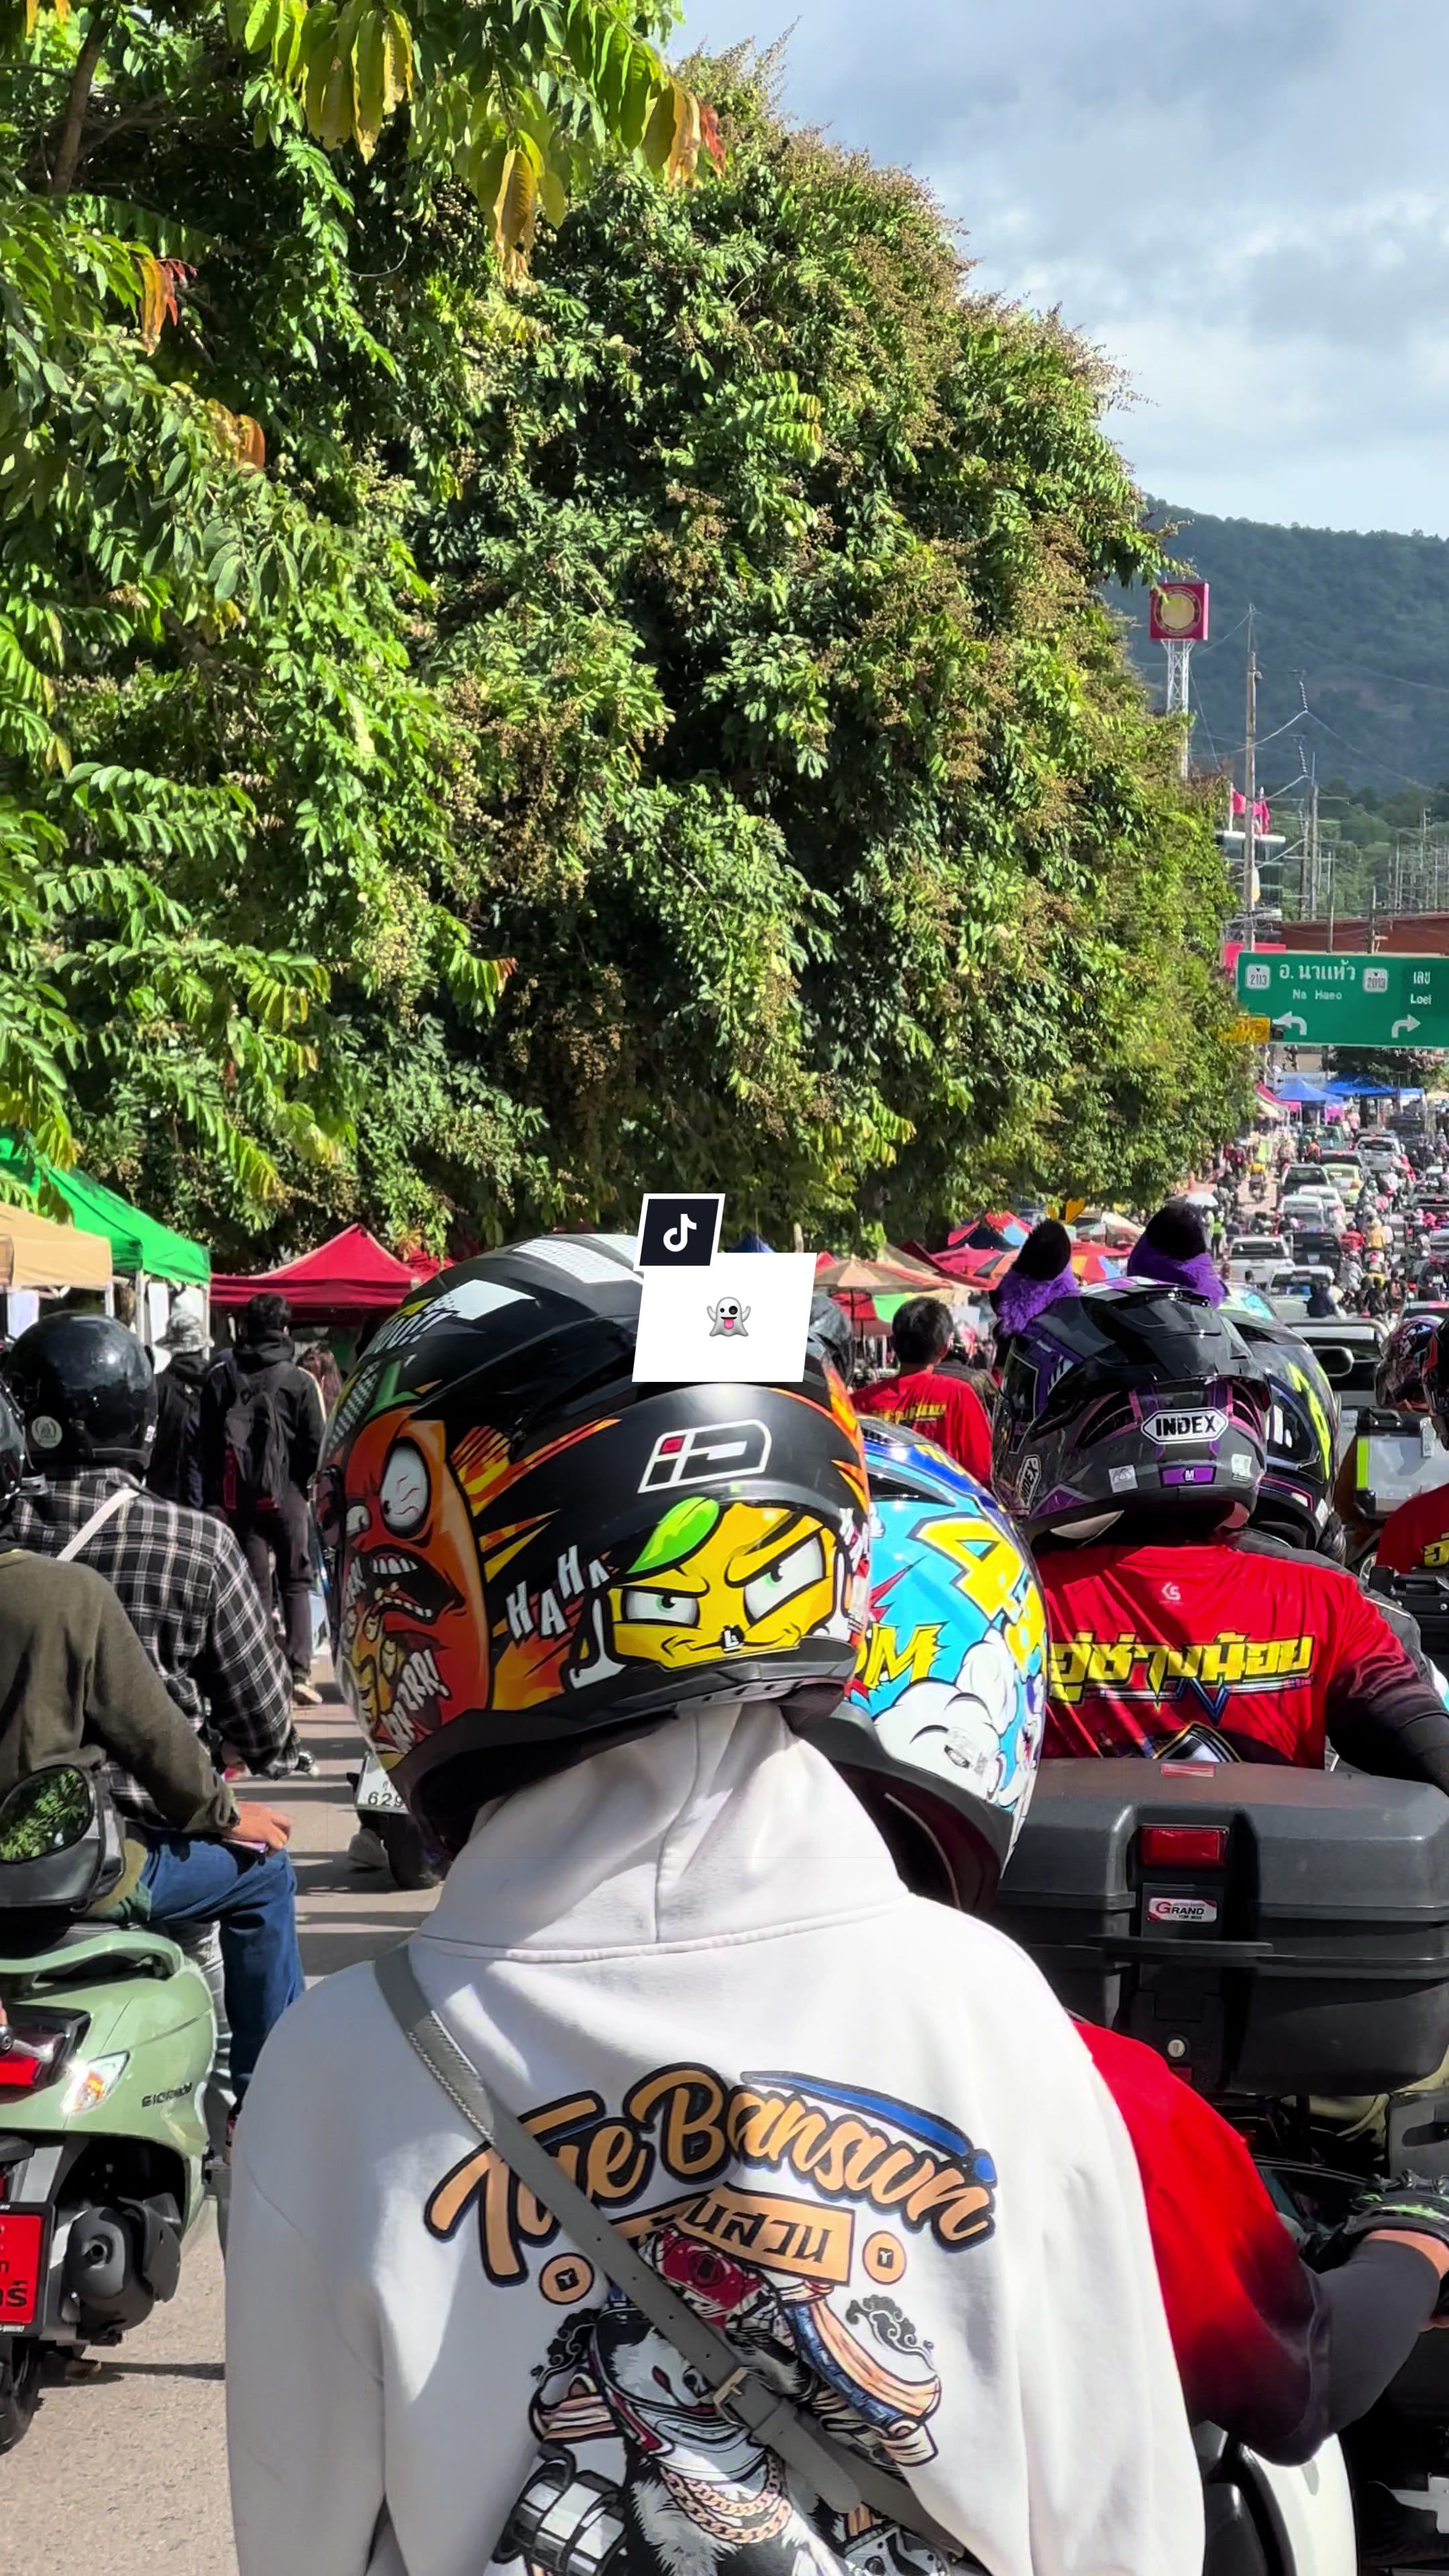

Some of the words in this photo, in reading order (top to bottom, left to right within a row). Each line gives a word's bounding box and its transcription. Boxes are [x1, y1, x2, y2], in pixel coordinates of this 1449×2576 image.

[1279, 964, 1294, 979] อ.
[1250, 974, 1267, 986] 2113
[1292, 988, 1307, 1000] Na
[1410, 993, 1432, 1005] Loei
[1155, 1415, 1216, 1437] INDEX
[1157, 1902, 1204, 1915] GRAND
